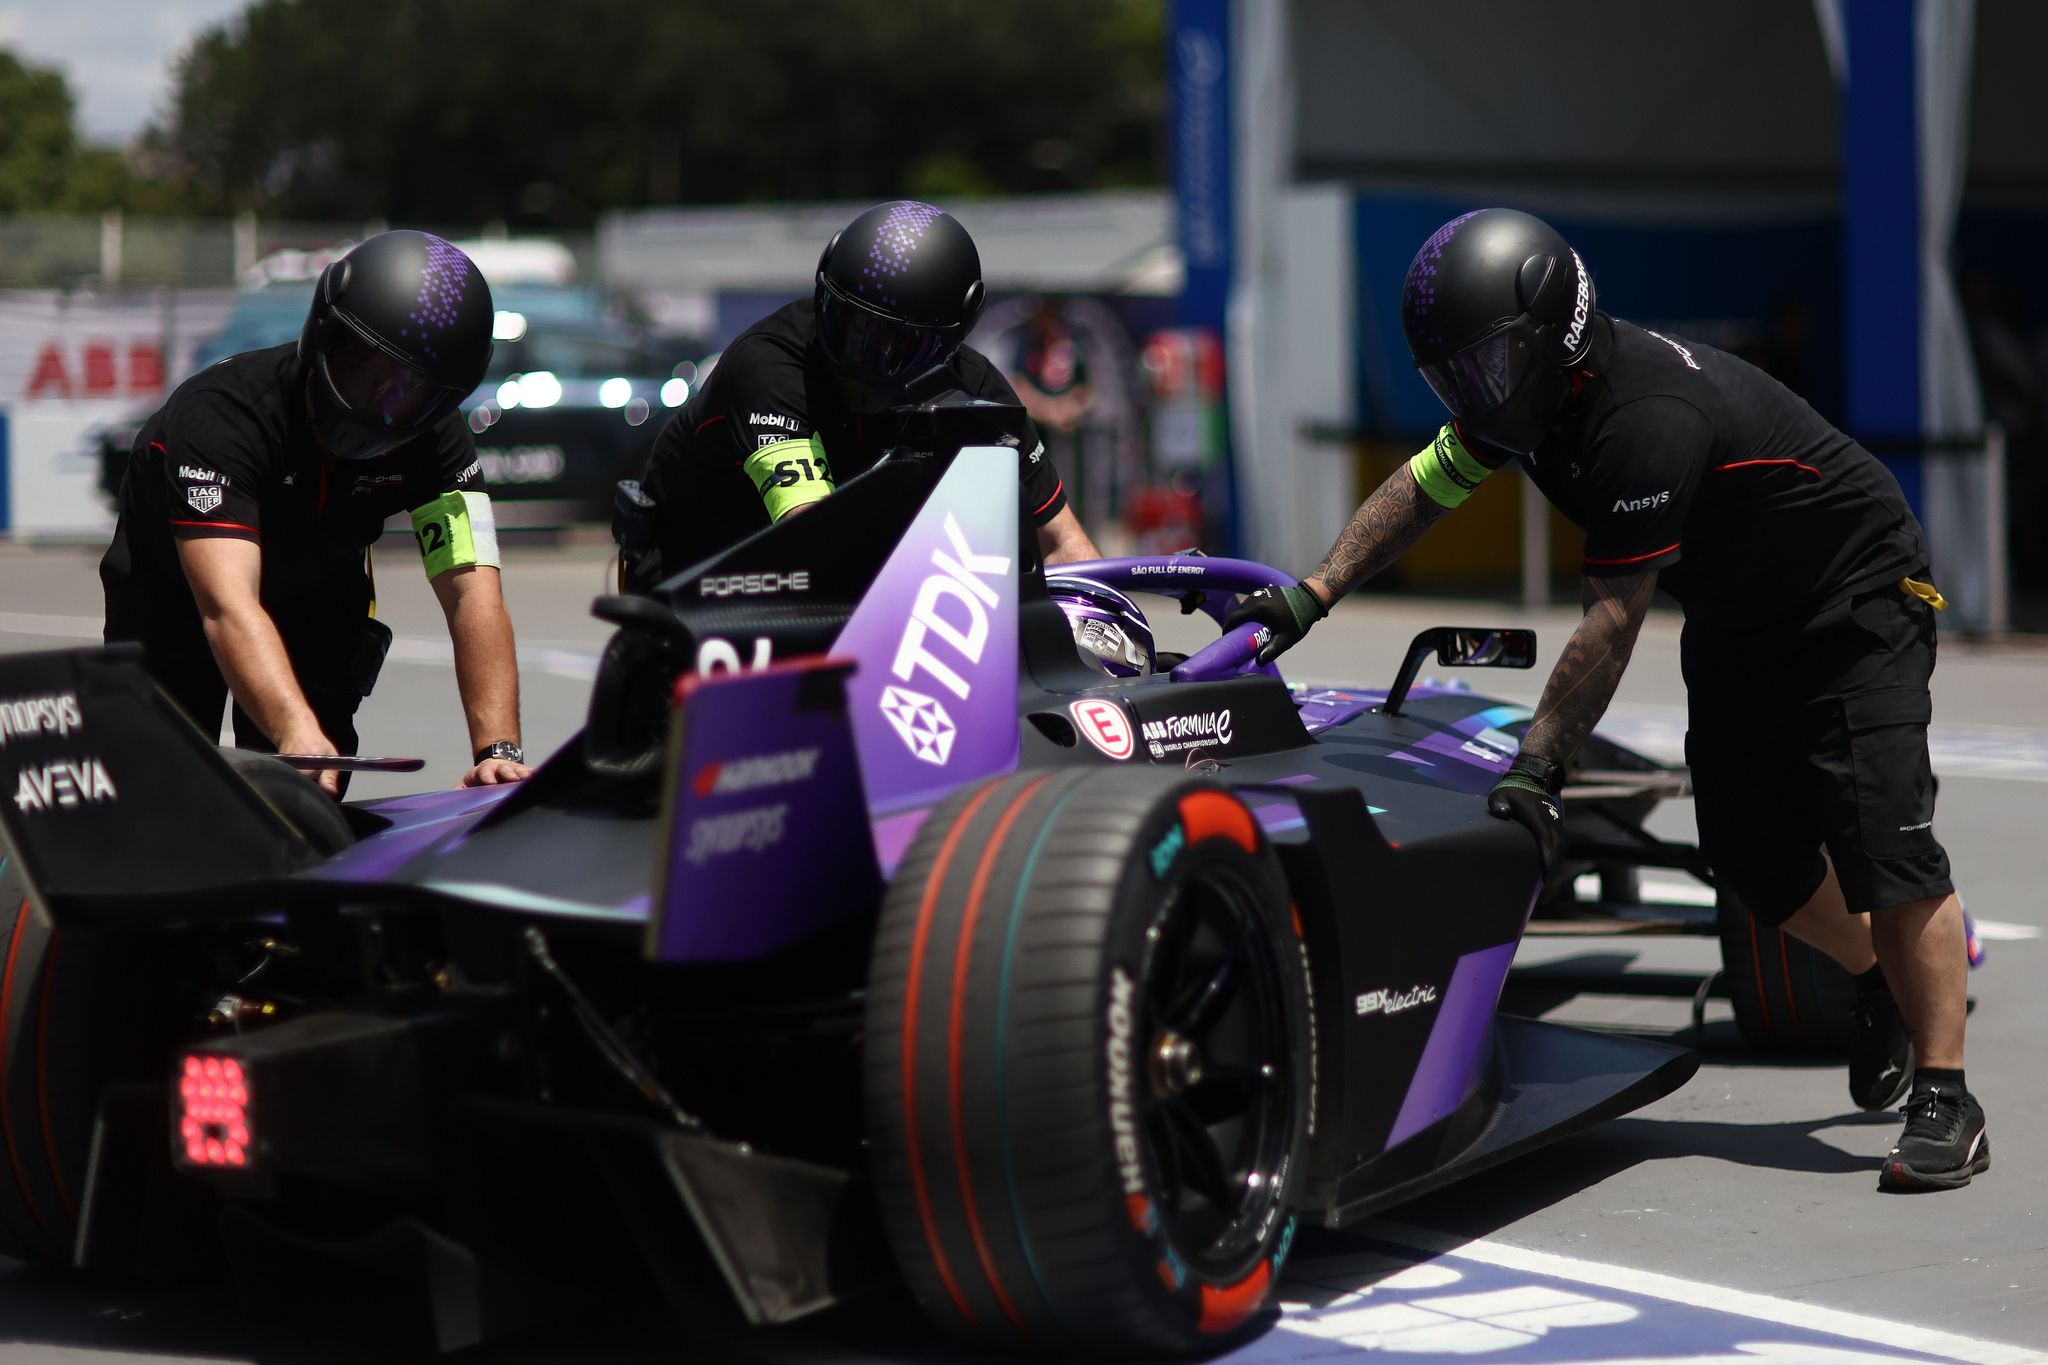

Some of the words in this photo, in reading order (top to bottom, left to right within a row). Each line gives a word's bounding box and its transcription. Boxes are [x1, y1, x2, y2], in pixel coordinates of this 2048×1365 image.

[27, 337, 167, 400] ABB
[748, 412, 785, 427] Mobil
[178, 465, 215, 481] Mobil
[774, 458, 833, 488] S12
[190, 487, 218, 497] TAG
[1612, 491, 1669, 512] Ansys
[189, 498, 220, 511] HEUER
[1148, 566, 1166, 574] FULL
[1167, 565, 1177, 574] OF
[1178, 566, 1205, 575] ENERGY
[701, 571, 809, 596] PORSCHE
[891, 511, 1011, 701] TDK
[1085, 707, 1122, 744] E
[1142, 721, 1167, 740] ABB
[1166, 712, 1217, 739] FORMULA
[1164, 743, 1183, 751] WORLD
[1183, 738, 1218, 749] CHAMPIONSHIP
[13, 761, 118, 811] AVEVA
